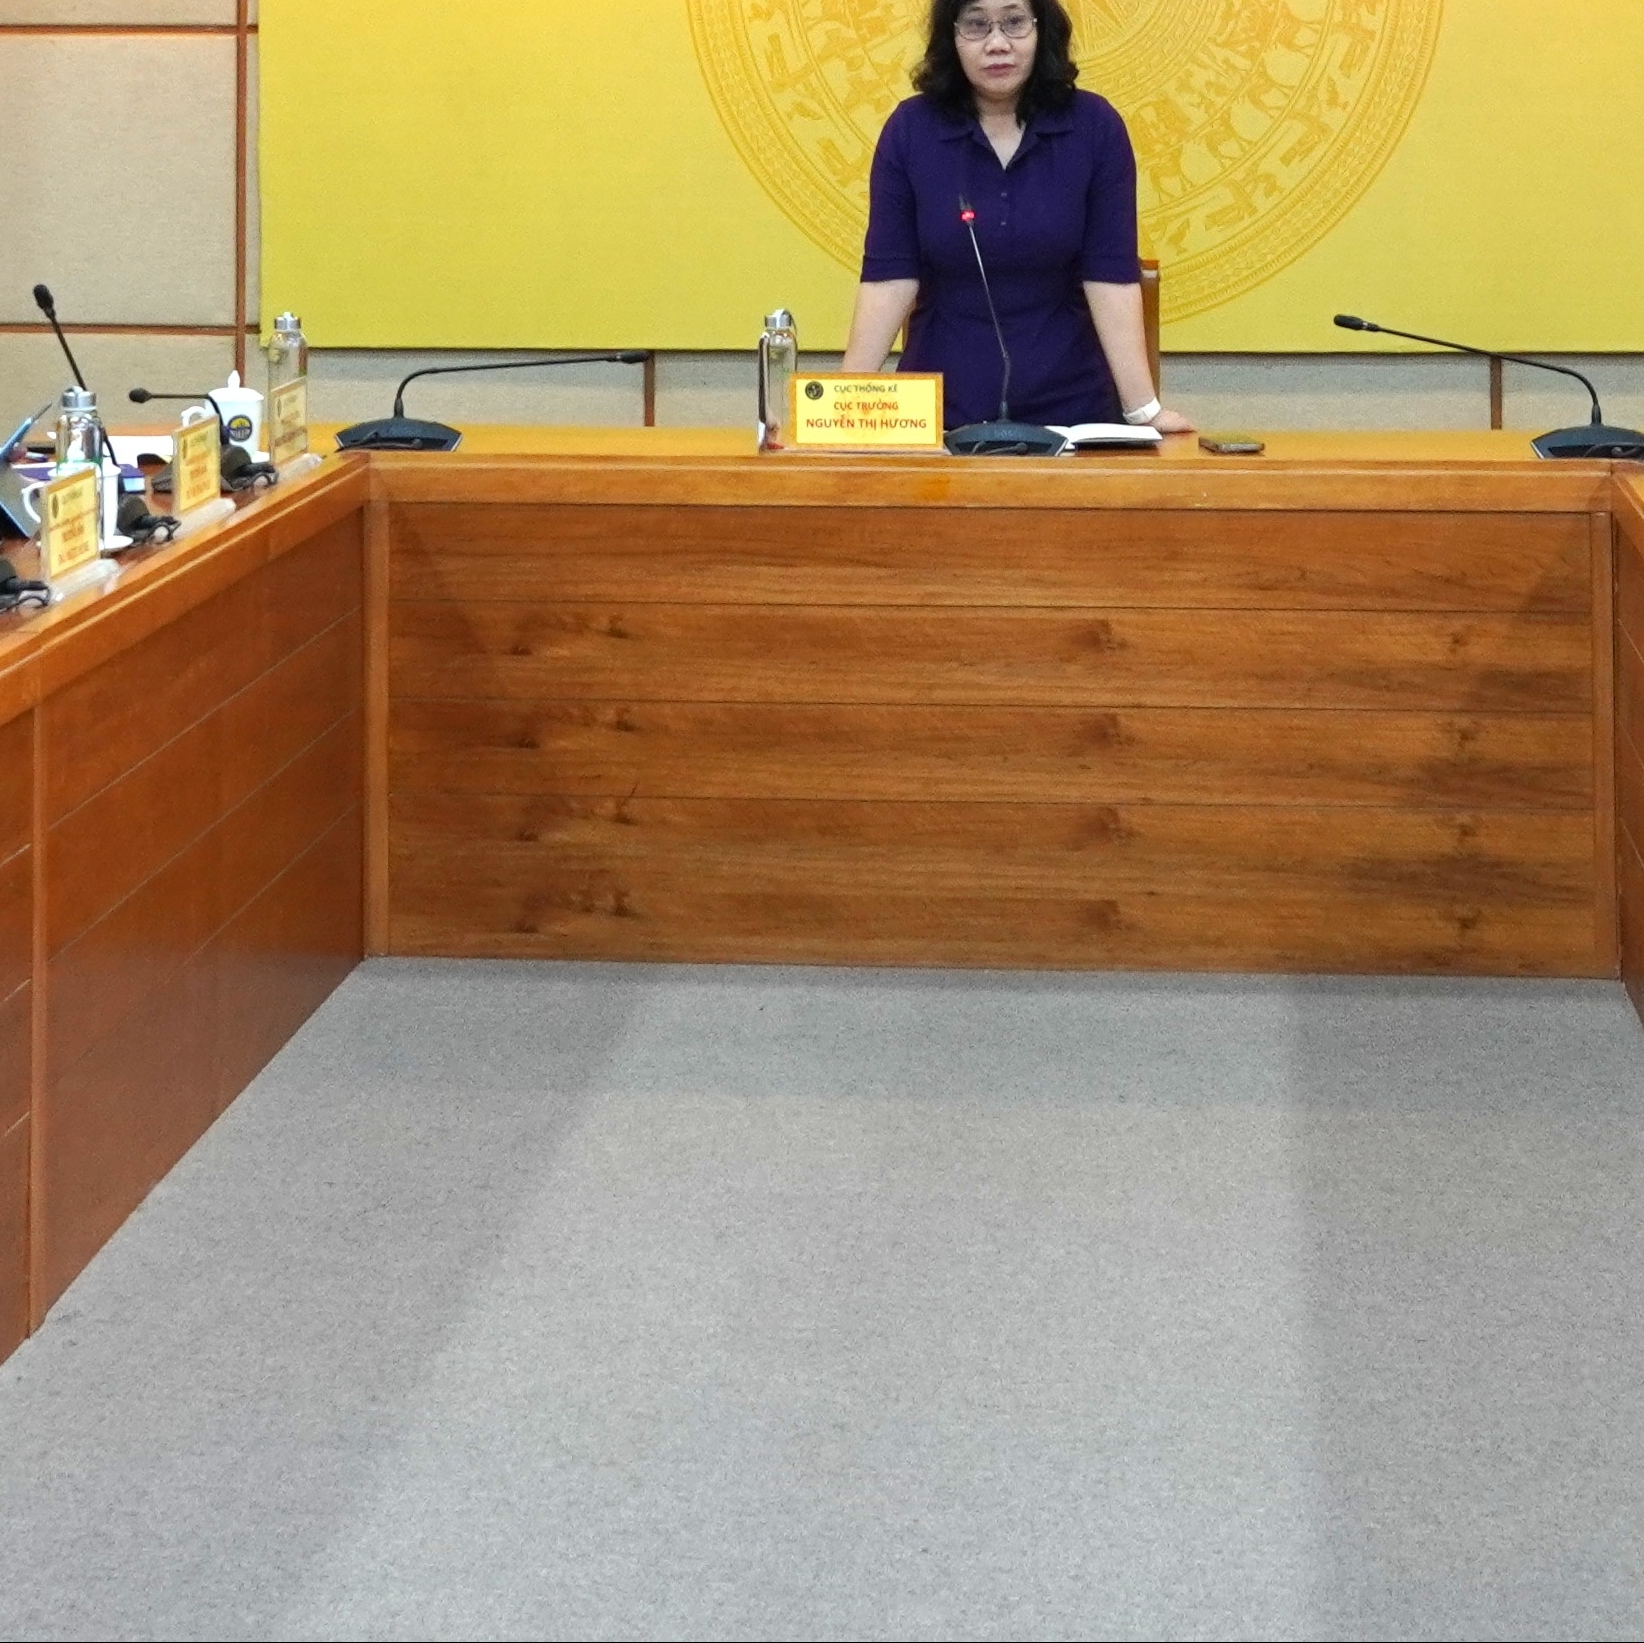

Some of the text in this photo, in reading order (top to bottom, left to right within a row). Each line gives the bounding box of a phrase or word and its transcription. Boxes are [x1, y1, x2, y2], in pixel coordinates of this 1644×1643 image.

[834, 382, 898, 394] CỤC THỐNG KÊ
[833, 398, 899, 412] CỤC TRƯỞNG
[806, 414, 927, 431] NGUYỄN THỊ HƯƠNG
